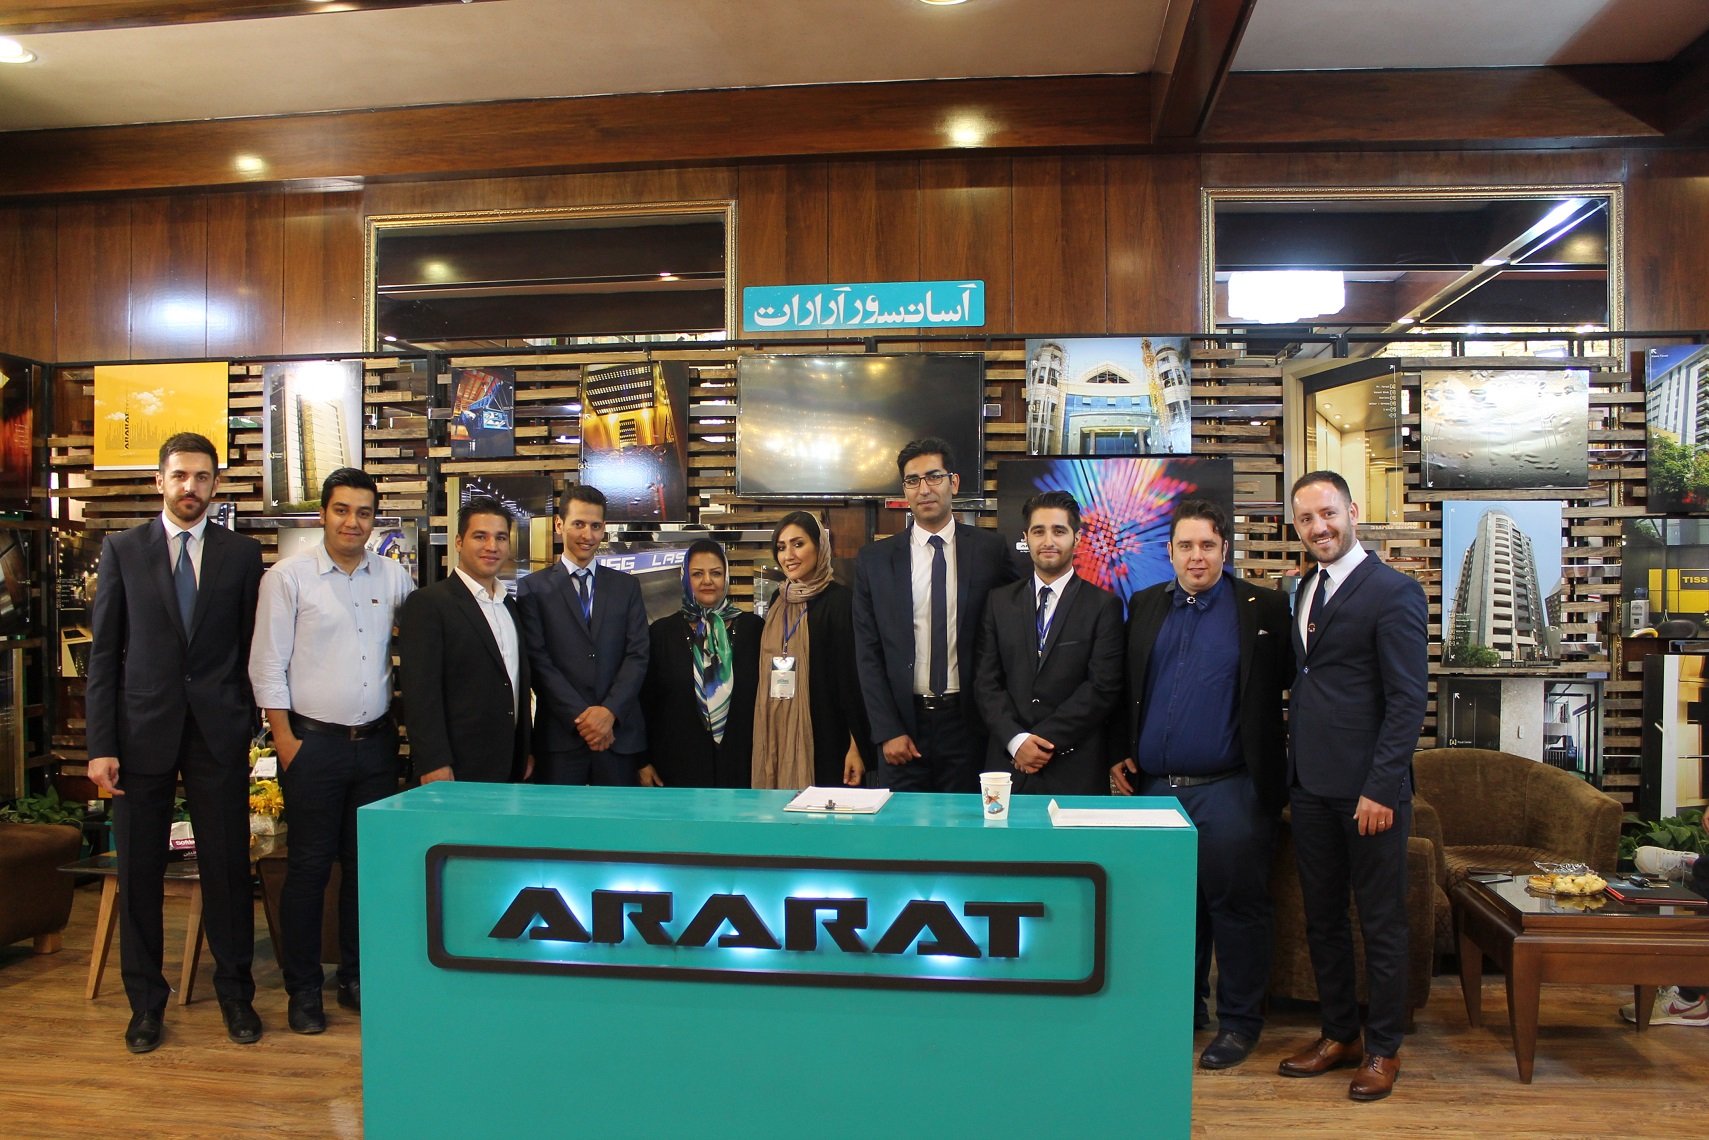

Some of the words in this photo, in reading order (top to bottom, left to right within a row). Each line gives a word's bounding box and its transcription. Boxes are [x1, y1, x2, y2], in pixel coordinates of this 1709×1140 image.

[753, 286, 852, 327] آرارات
[1682, 576, 1709, 584] TISS
[487, 886, 1044, 959] ARARAT
